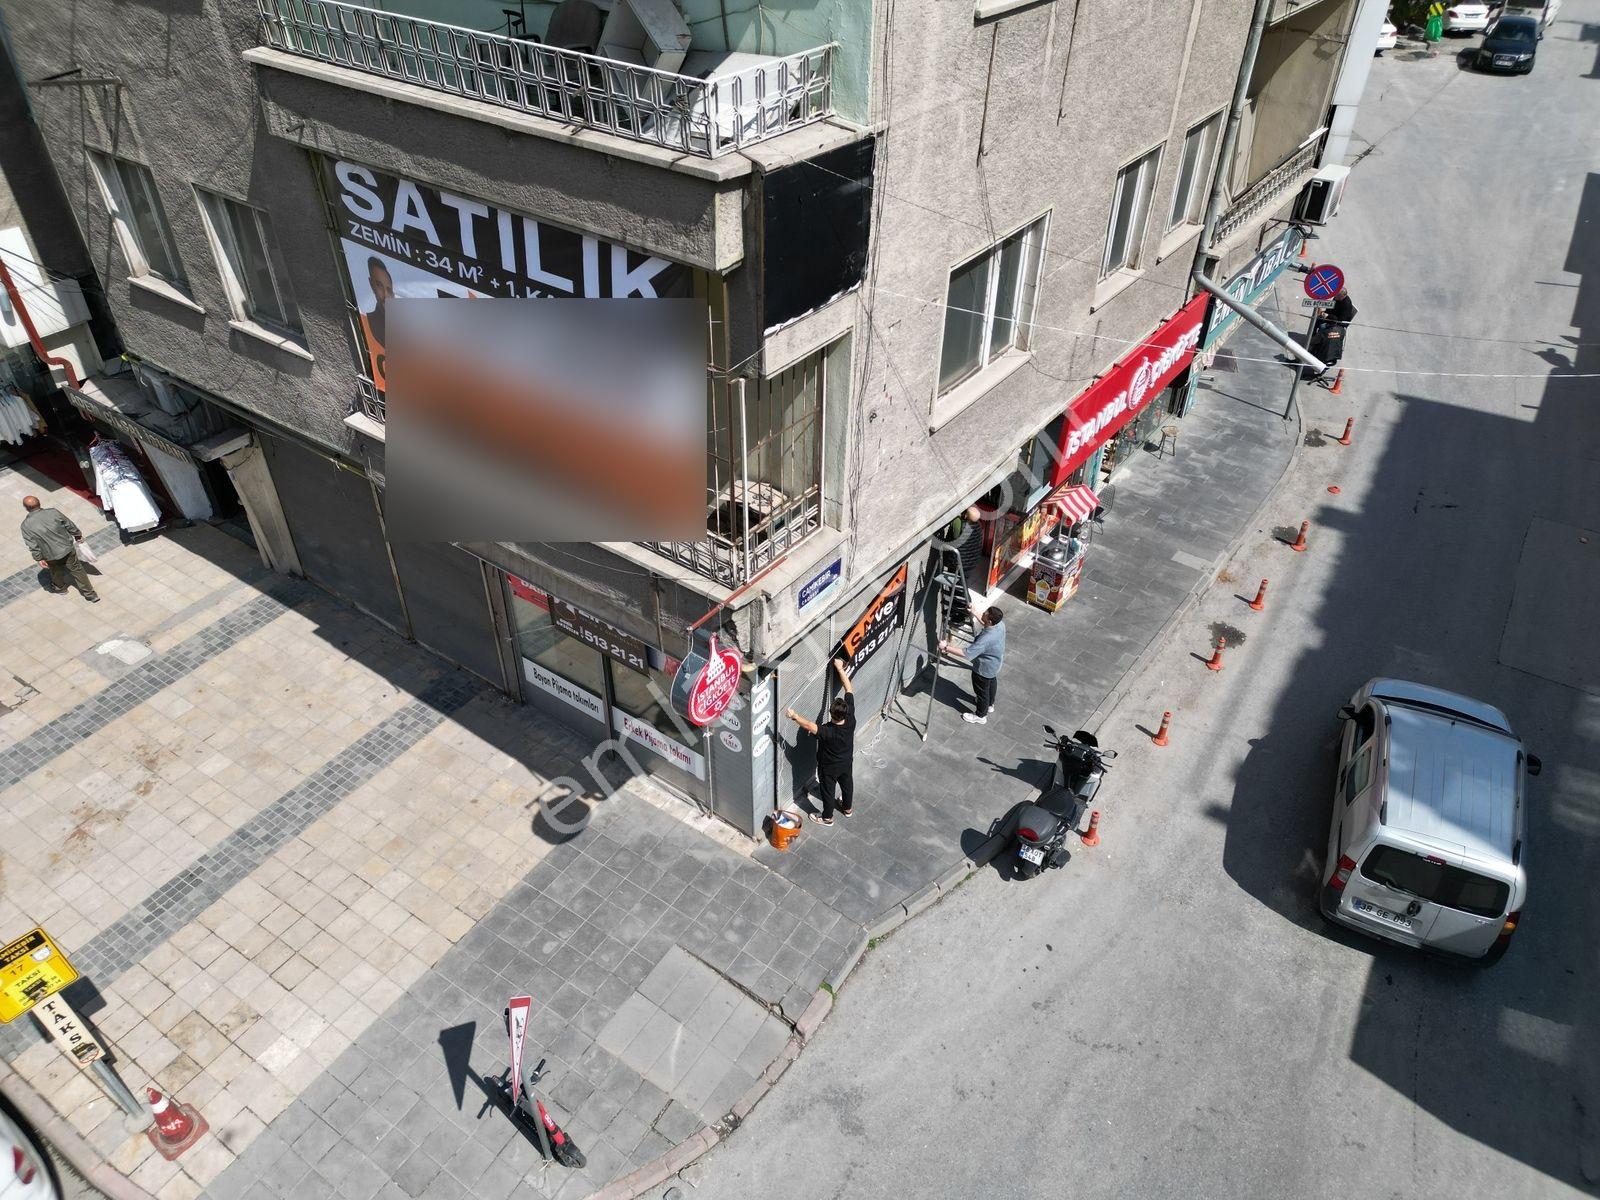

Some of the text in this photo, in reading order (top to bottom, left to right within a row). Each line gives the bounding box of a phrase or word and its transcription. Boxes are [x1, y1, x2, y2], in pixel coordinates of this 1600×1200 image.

[334, 160, 672, 298] SATILIK
[348, 220, 411, 259] ZEMİN
[584, 628, 644, 669] 513 21 21
[532, 667, 551, 686] Bayan
[551, 677, 572, 699] Pijama
[623, 717, 643, 738] Erkek
[42, 1000, 83, 1045] TAKS
